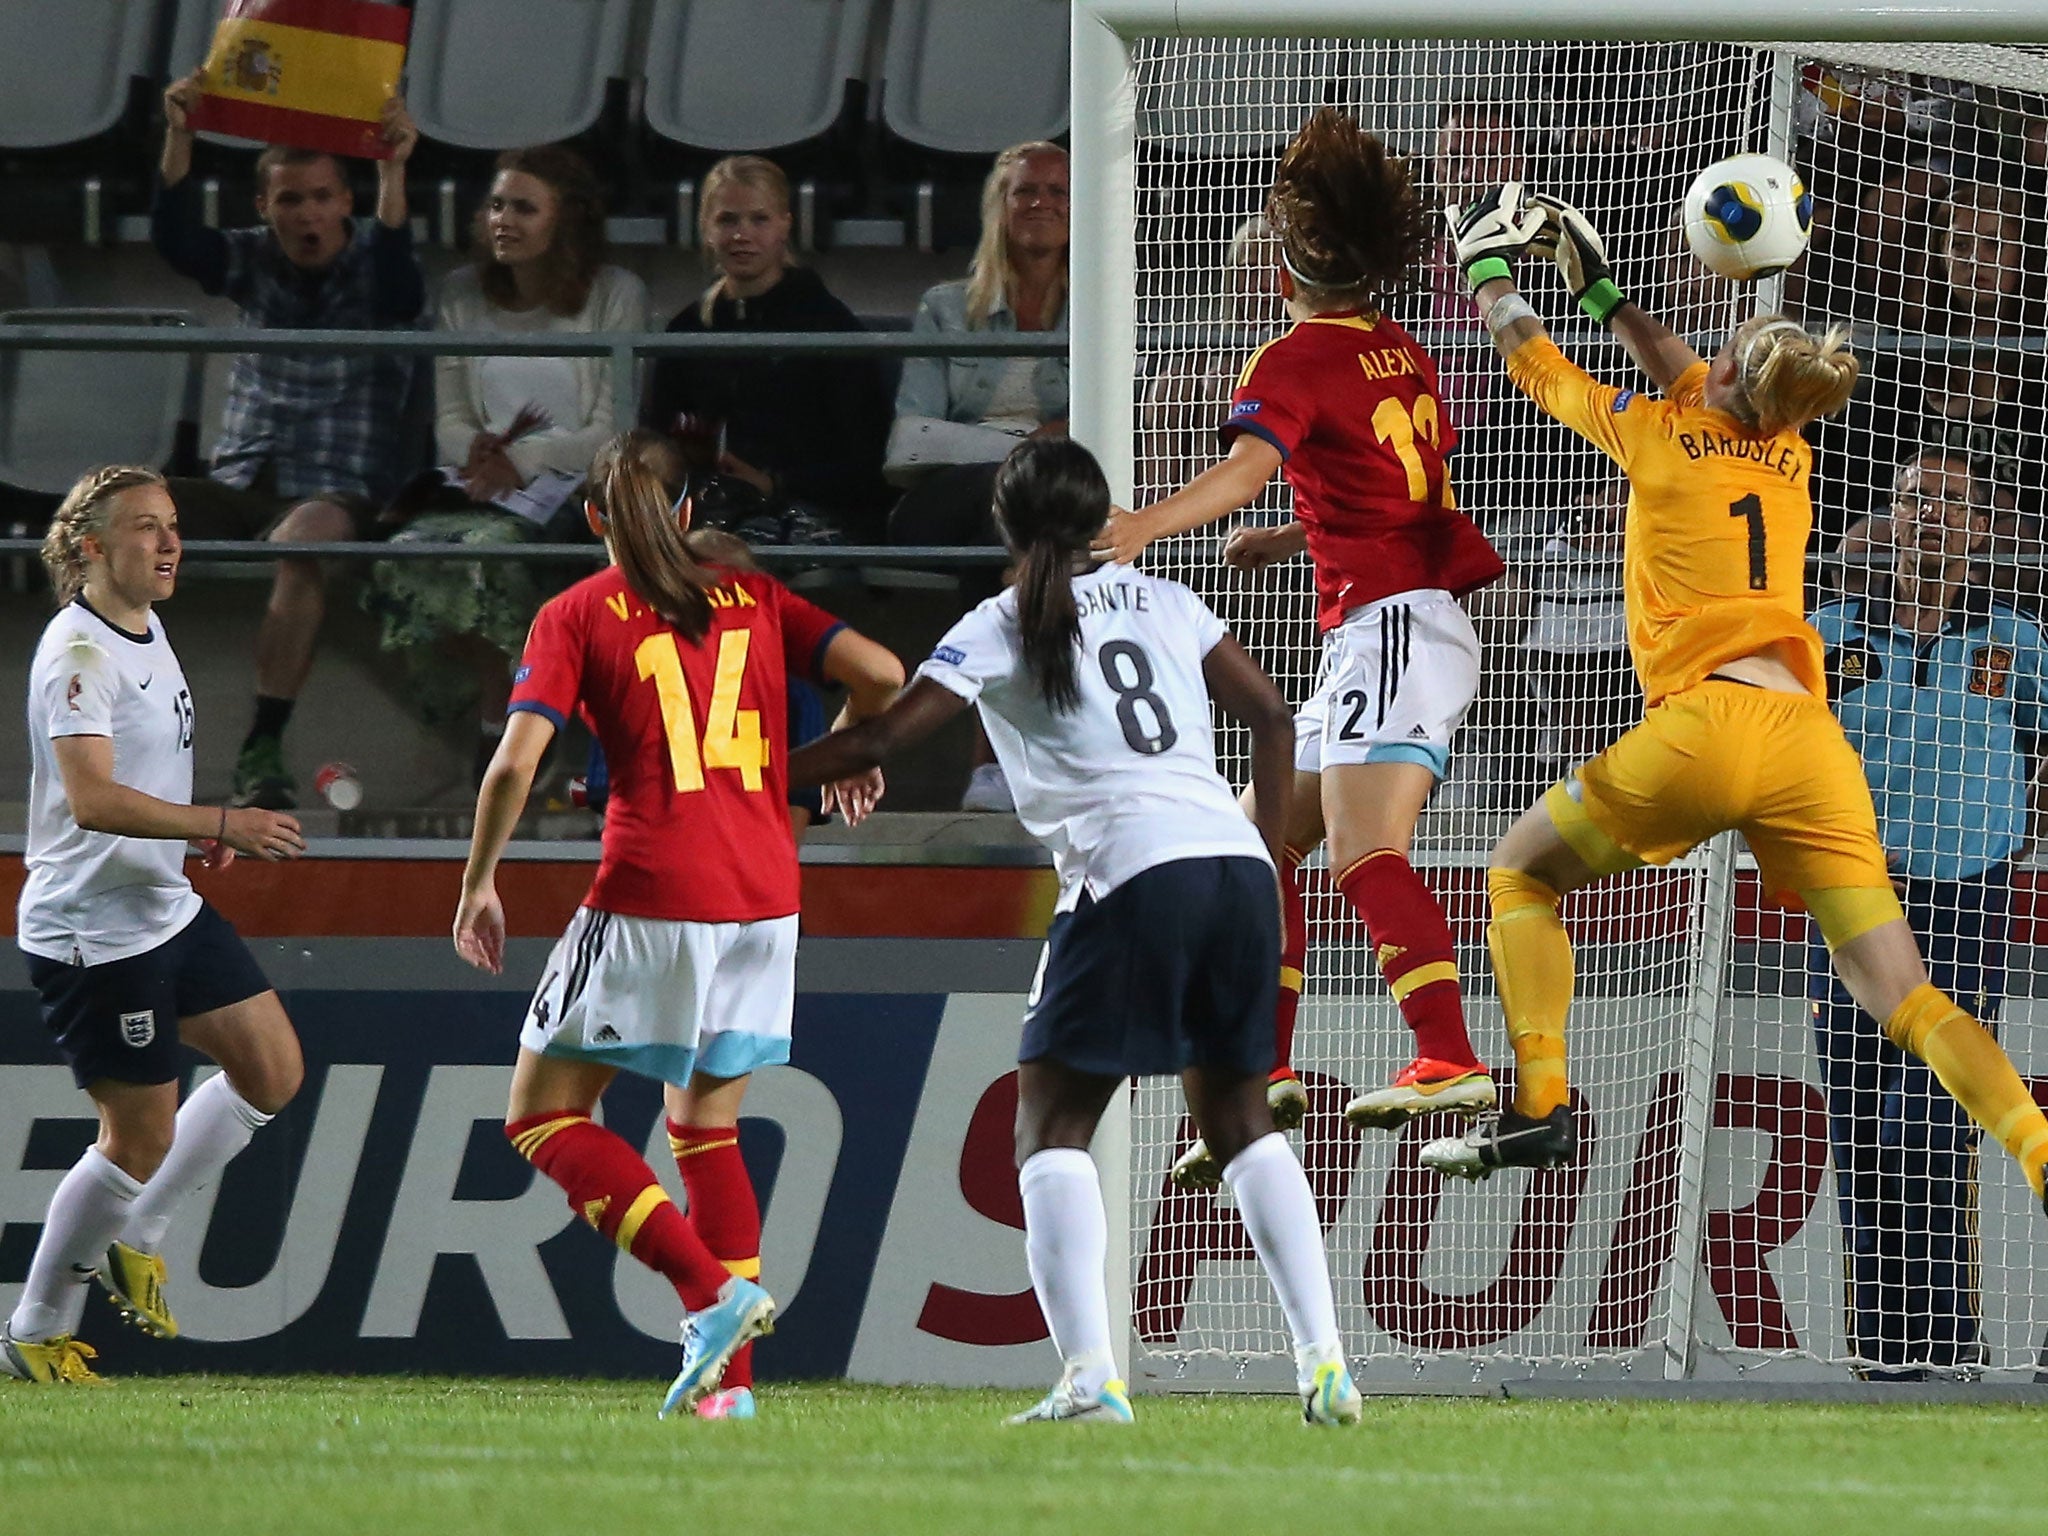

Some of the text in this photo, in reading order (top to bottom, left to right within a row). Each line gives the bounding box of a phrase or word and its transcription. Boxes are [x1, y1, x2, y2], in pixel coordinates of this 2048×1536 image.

[1679, 429, 1802, 482] BARDSLEY
[1729, 493, 1767, 590] 1
[174, 689, 193, 754] 15
[634, 628, 770, 793] 14
[1099, 640, 1178, 754] 8
[0, 1060, 2048, 1348] EUROSPOR
